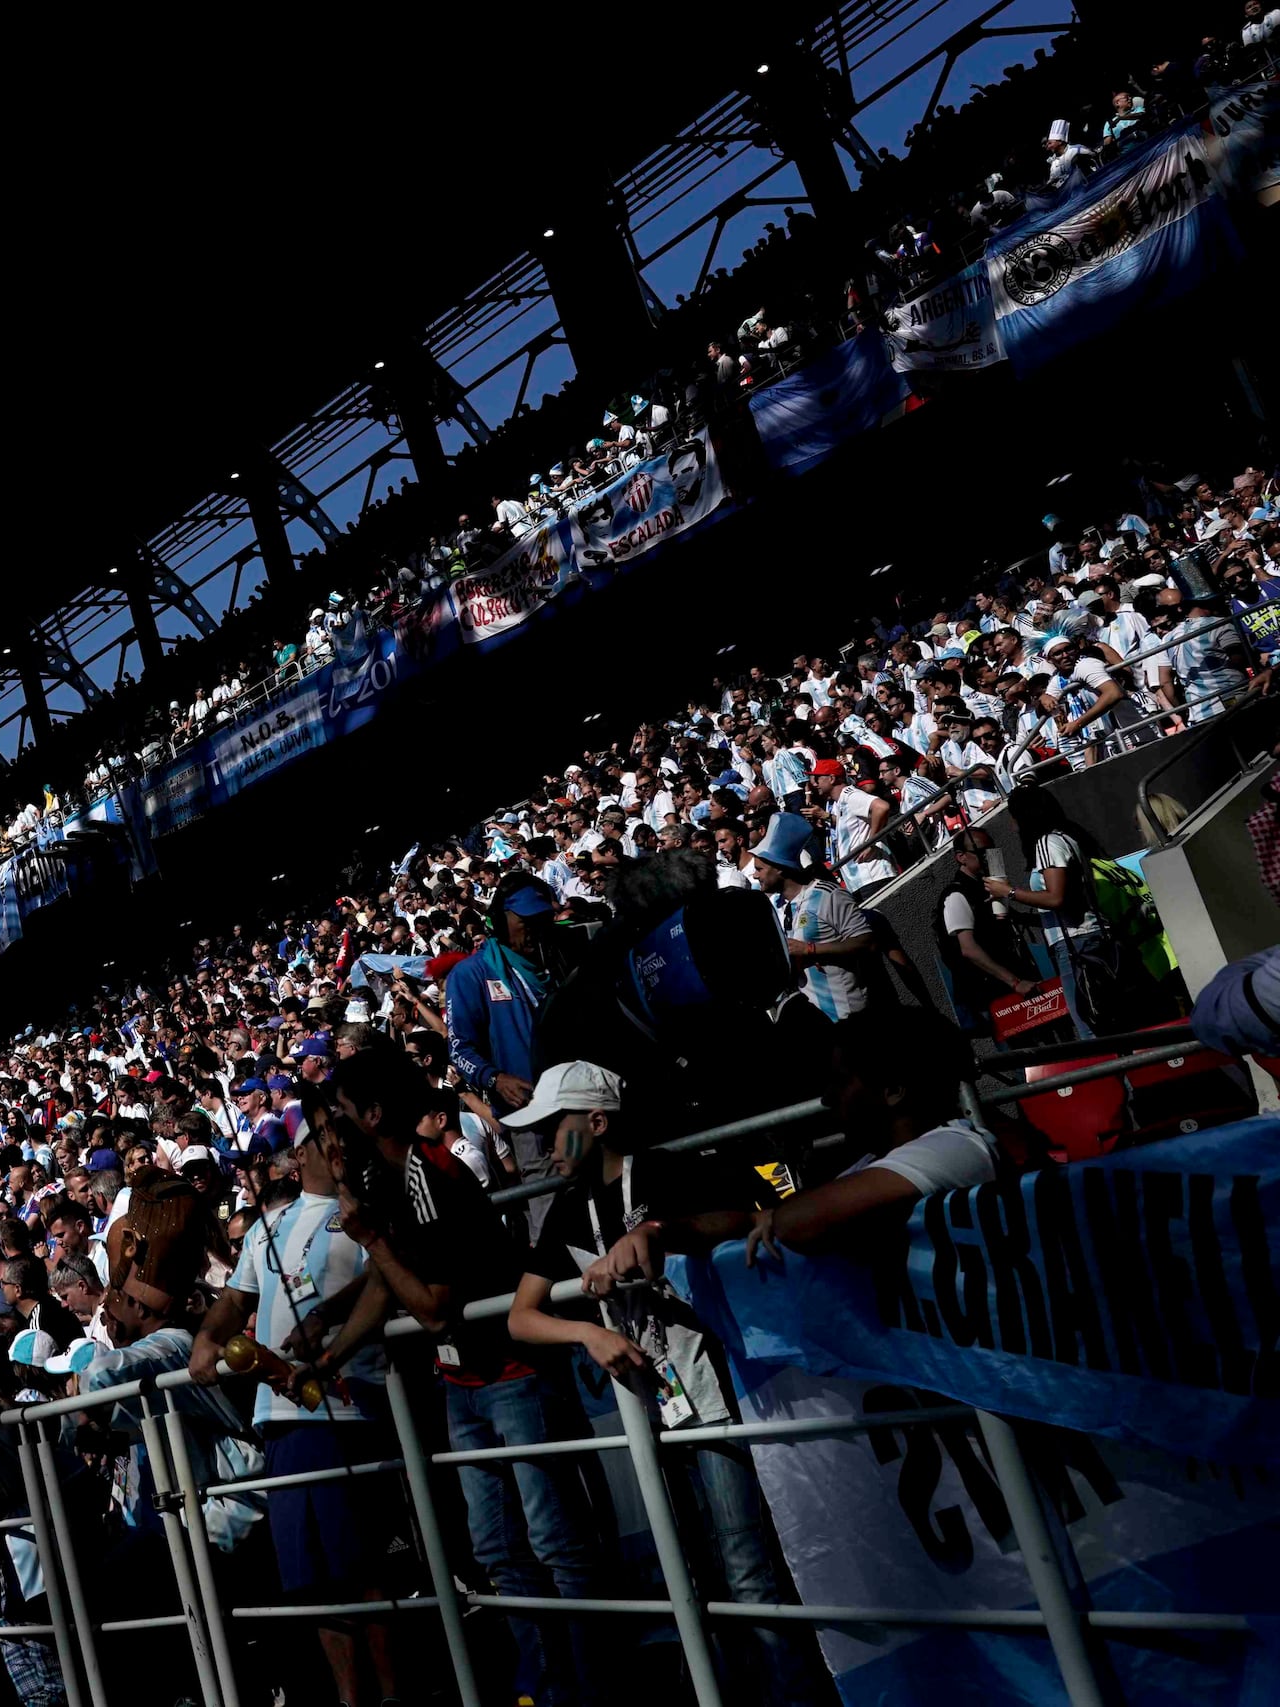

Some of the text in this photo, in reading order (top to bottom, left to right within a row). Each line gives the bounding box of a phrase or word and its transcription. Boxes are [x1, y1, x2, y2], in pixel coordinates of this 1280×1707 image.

[910, 273, 992, 327] ARGENTIN
[608, 503, 685, 559] ESCALADA
[239, 747, 277, 779] CALETA
[279, 726, 312, 755] OLIVIA
[240, 710, 296, 753] N.O.B.
[670, 923, 684, 939] FIFA
[1020, 999, 1034, 1009] THE
[1031, 995, 1046, 1005] FIFA
